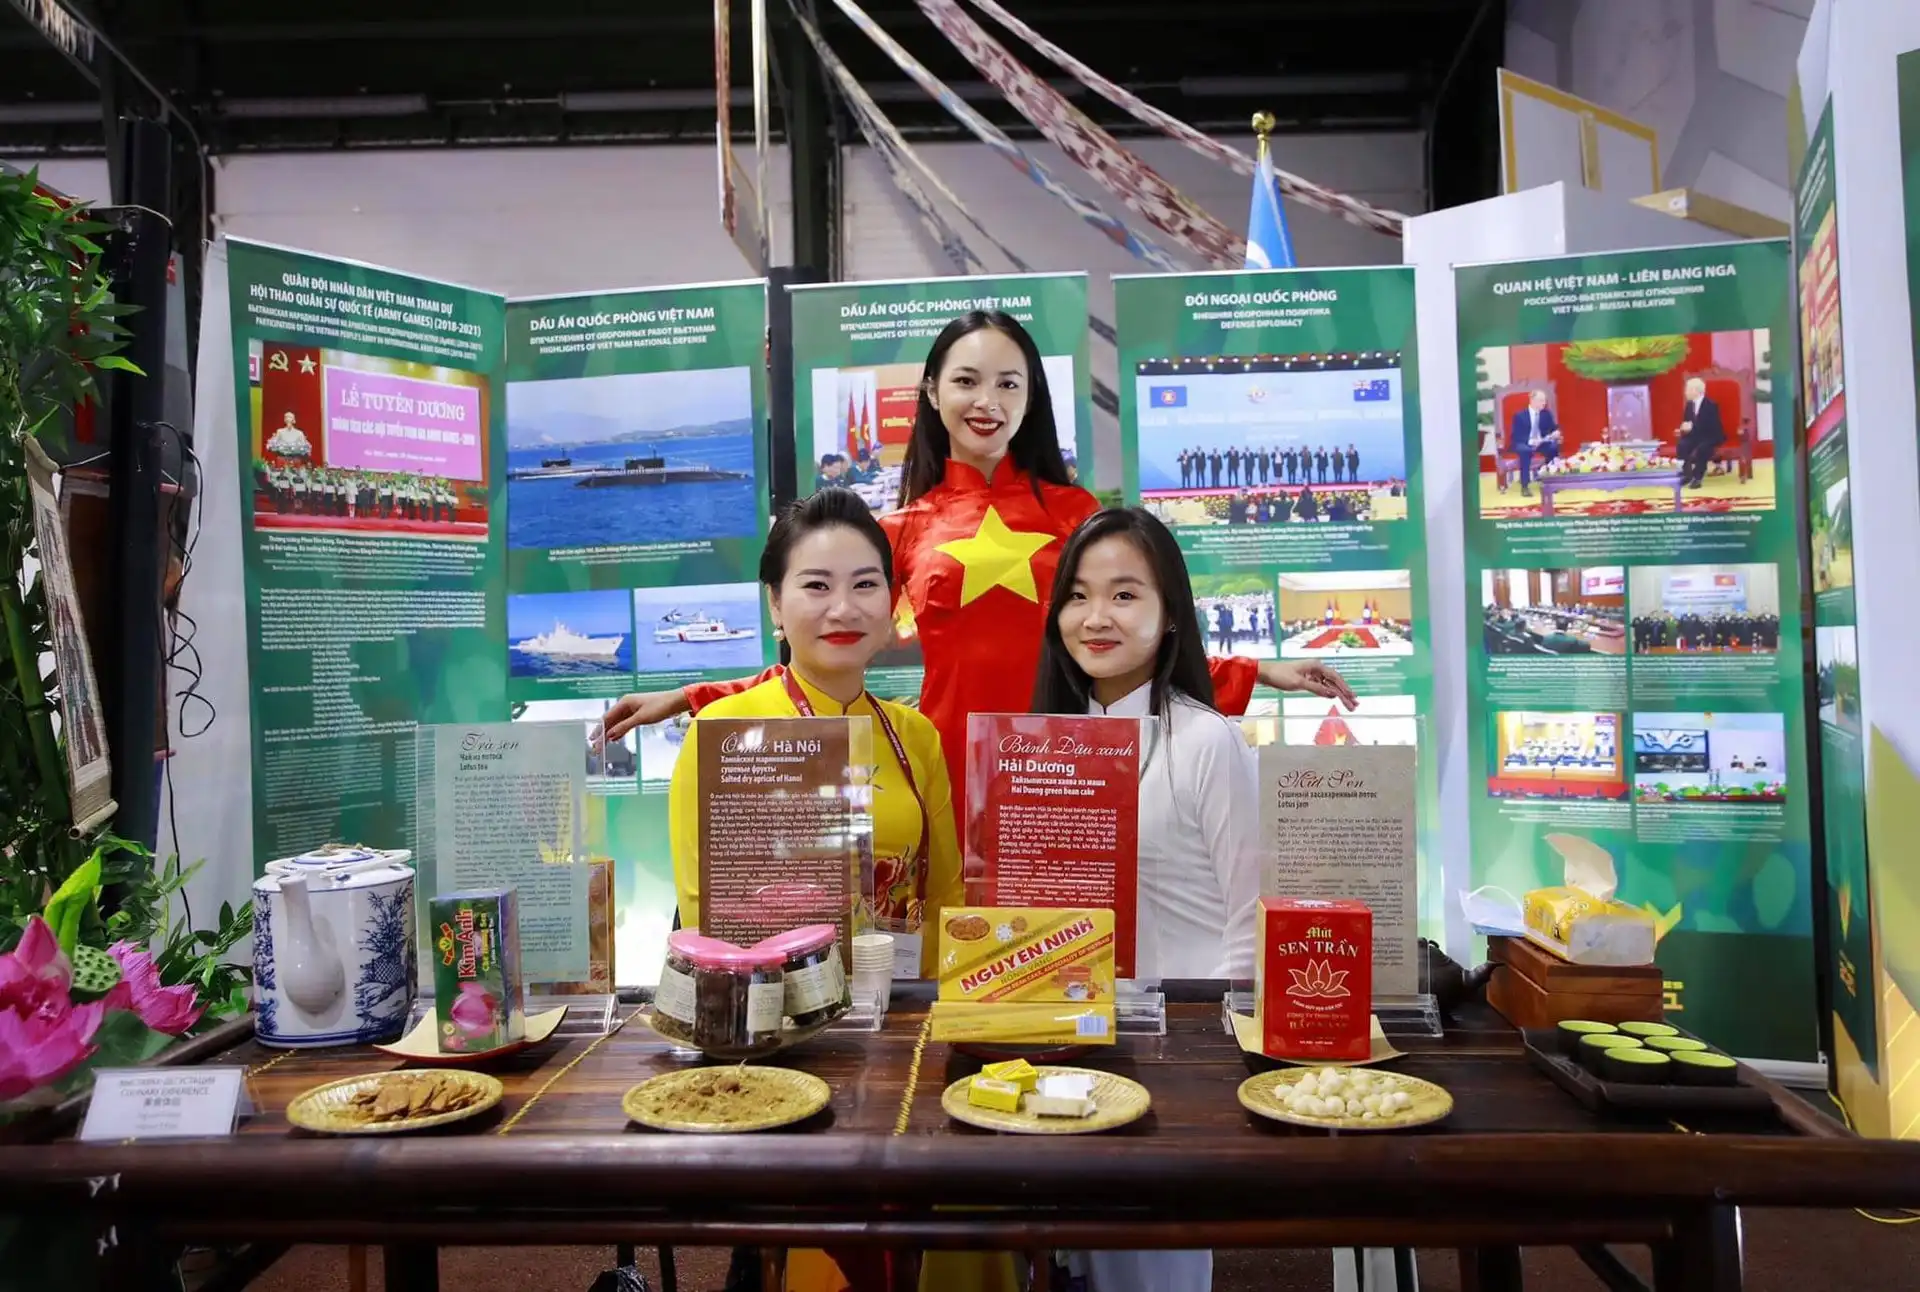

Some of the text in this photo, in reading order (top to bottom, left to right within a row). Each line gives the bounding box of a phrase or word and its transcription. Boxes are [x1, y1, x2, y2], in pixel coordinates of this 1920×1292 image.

[1493, 280, 1532, 295] QUAN
[1534, 276, 1552, 292] HỆ
[1554, 275, 1585, 291] VIỆT
[1586, 272, 1619, 287] NAM
[1629, 268, 1659, 283] LIÊN
[1662, 266, 1702, 281] BANG
[1704, 263, 1736, 277] NGA
[282, 272, 309, 289] QUÂN
[311, 276, 328, 294] ĐỘI
[329, 281, 355, 297] NHÂN
[375, 289, 395, 306] VIỆT
[396, 293, 415, 308] NAM
[416, 297, 439, 312] THAM
[1185, 288, 1337, 307] ĐỐI NGOẠI QUỐC PHÒNG
[250, 283, 267, 300] HỘI
[295, 292, 322, 308] QUÂN
[338, 299, 361, 314] QUỐC
[362, 301, 373, 317] TẾ
[374, 306, 402, 322] (ARMY
[402, 311, 433, 329] GAMES)
[434, 317, 481, 338] (2018-2021)
[841, 303, 866, 317] DẤU
[869, 301, 887, 315] ẤN
[888, 299, 924, 315] QUỐC
[926, 297, 971, 312] PHÒNG
[1002, 295, 1032, 308] NAM
[530, 307, 715, 331] DẤU ẤN QUỐC PHÒNG VIỆT NAM
[897, 330, 907, 338] OF
[585, 343, 595, 351] OF
[497, 741, 519, 751] sen
[774, 740, 792, 753] Hà
[796, 739, 821, 756] Nội
[998, 734, 1050, 754] Bánh
[1095, 741, 1134, 757] xanh
[998, 758, 1075, 776] Hải Dương
[454, 908, 477, 978] Kim Anh
[1043, 917, 1096, 951] NINH
[1278, 938, 1359, 958] SEN TRẦN
